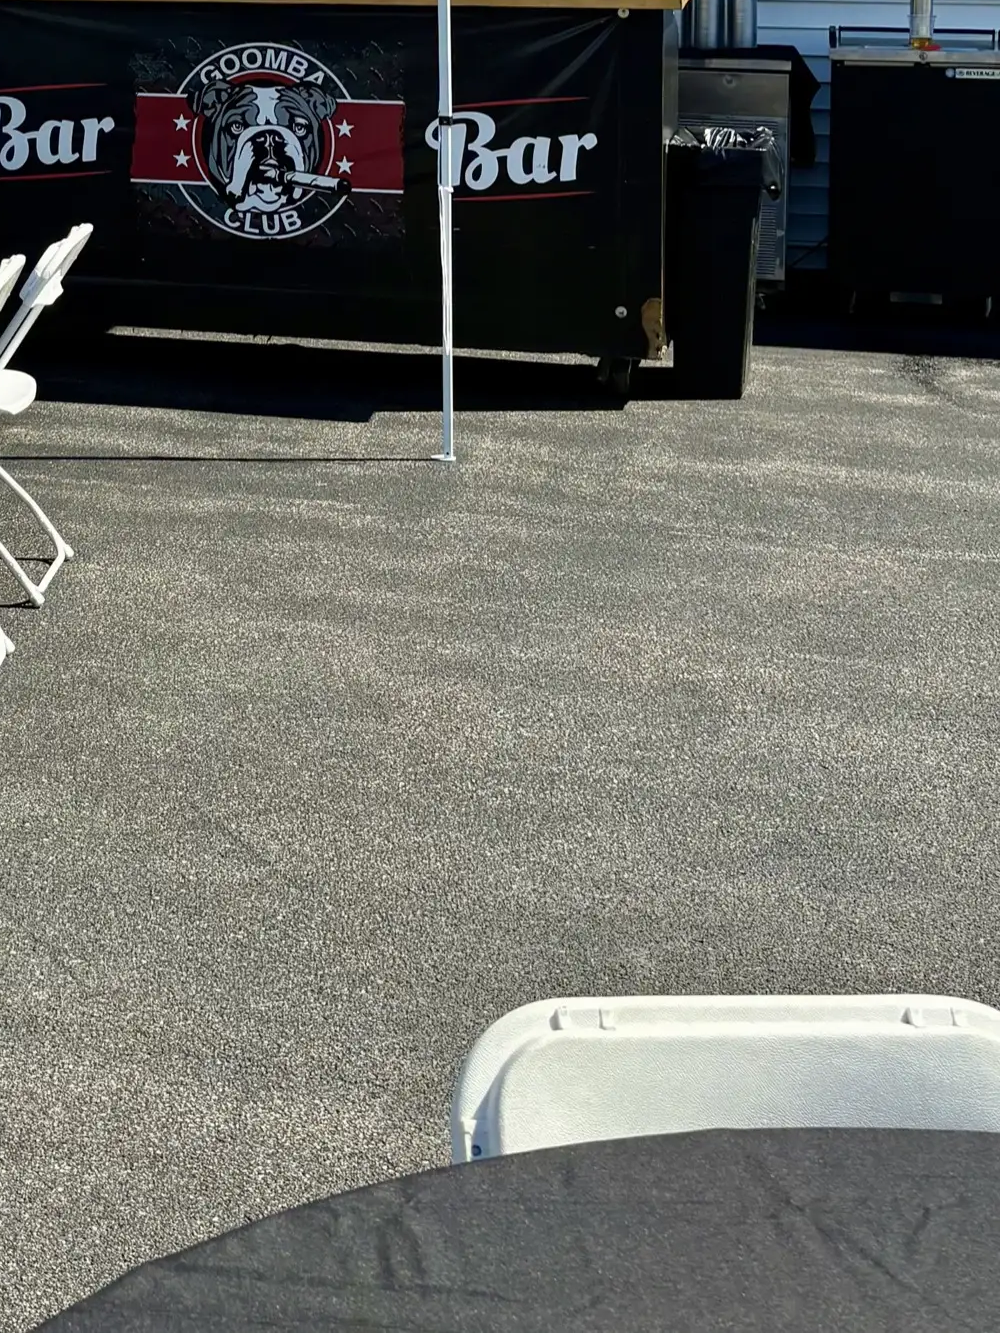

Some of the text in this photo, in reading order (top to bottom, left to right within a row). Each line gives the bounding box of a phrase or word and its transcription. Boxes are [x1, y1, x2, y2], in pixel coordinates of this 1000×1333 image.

[200, 48, 326, 87] GOOMBA
[424, 111, 598, 191] Bar
[223, 208, 302, 235] CLUB
